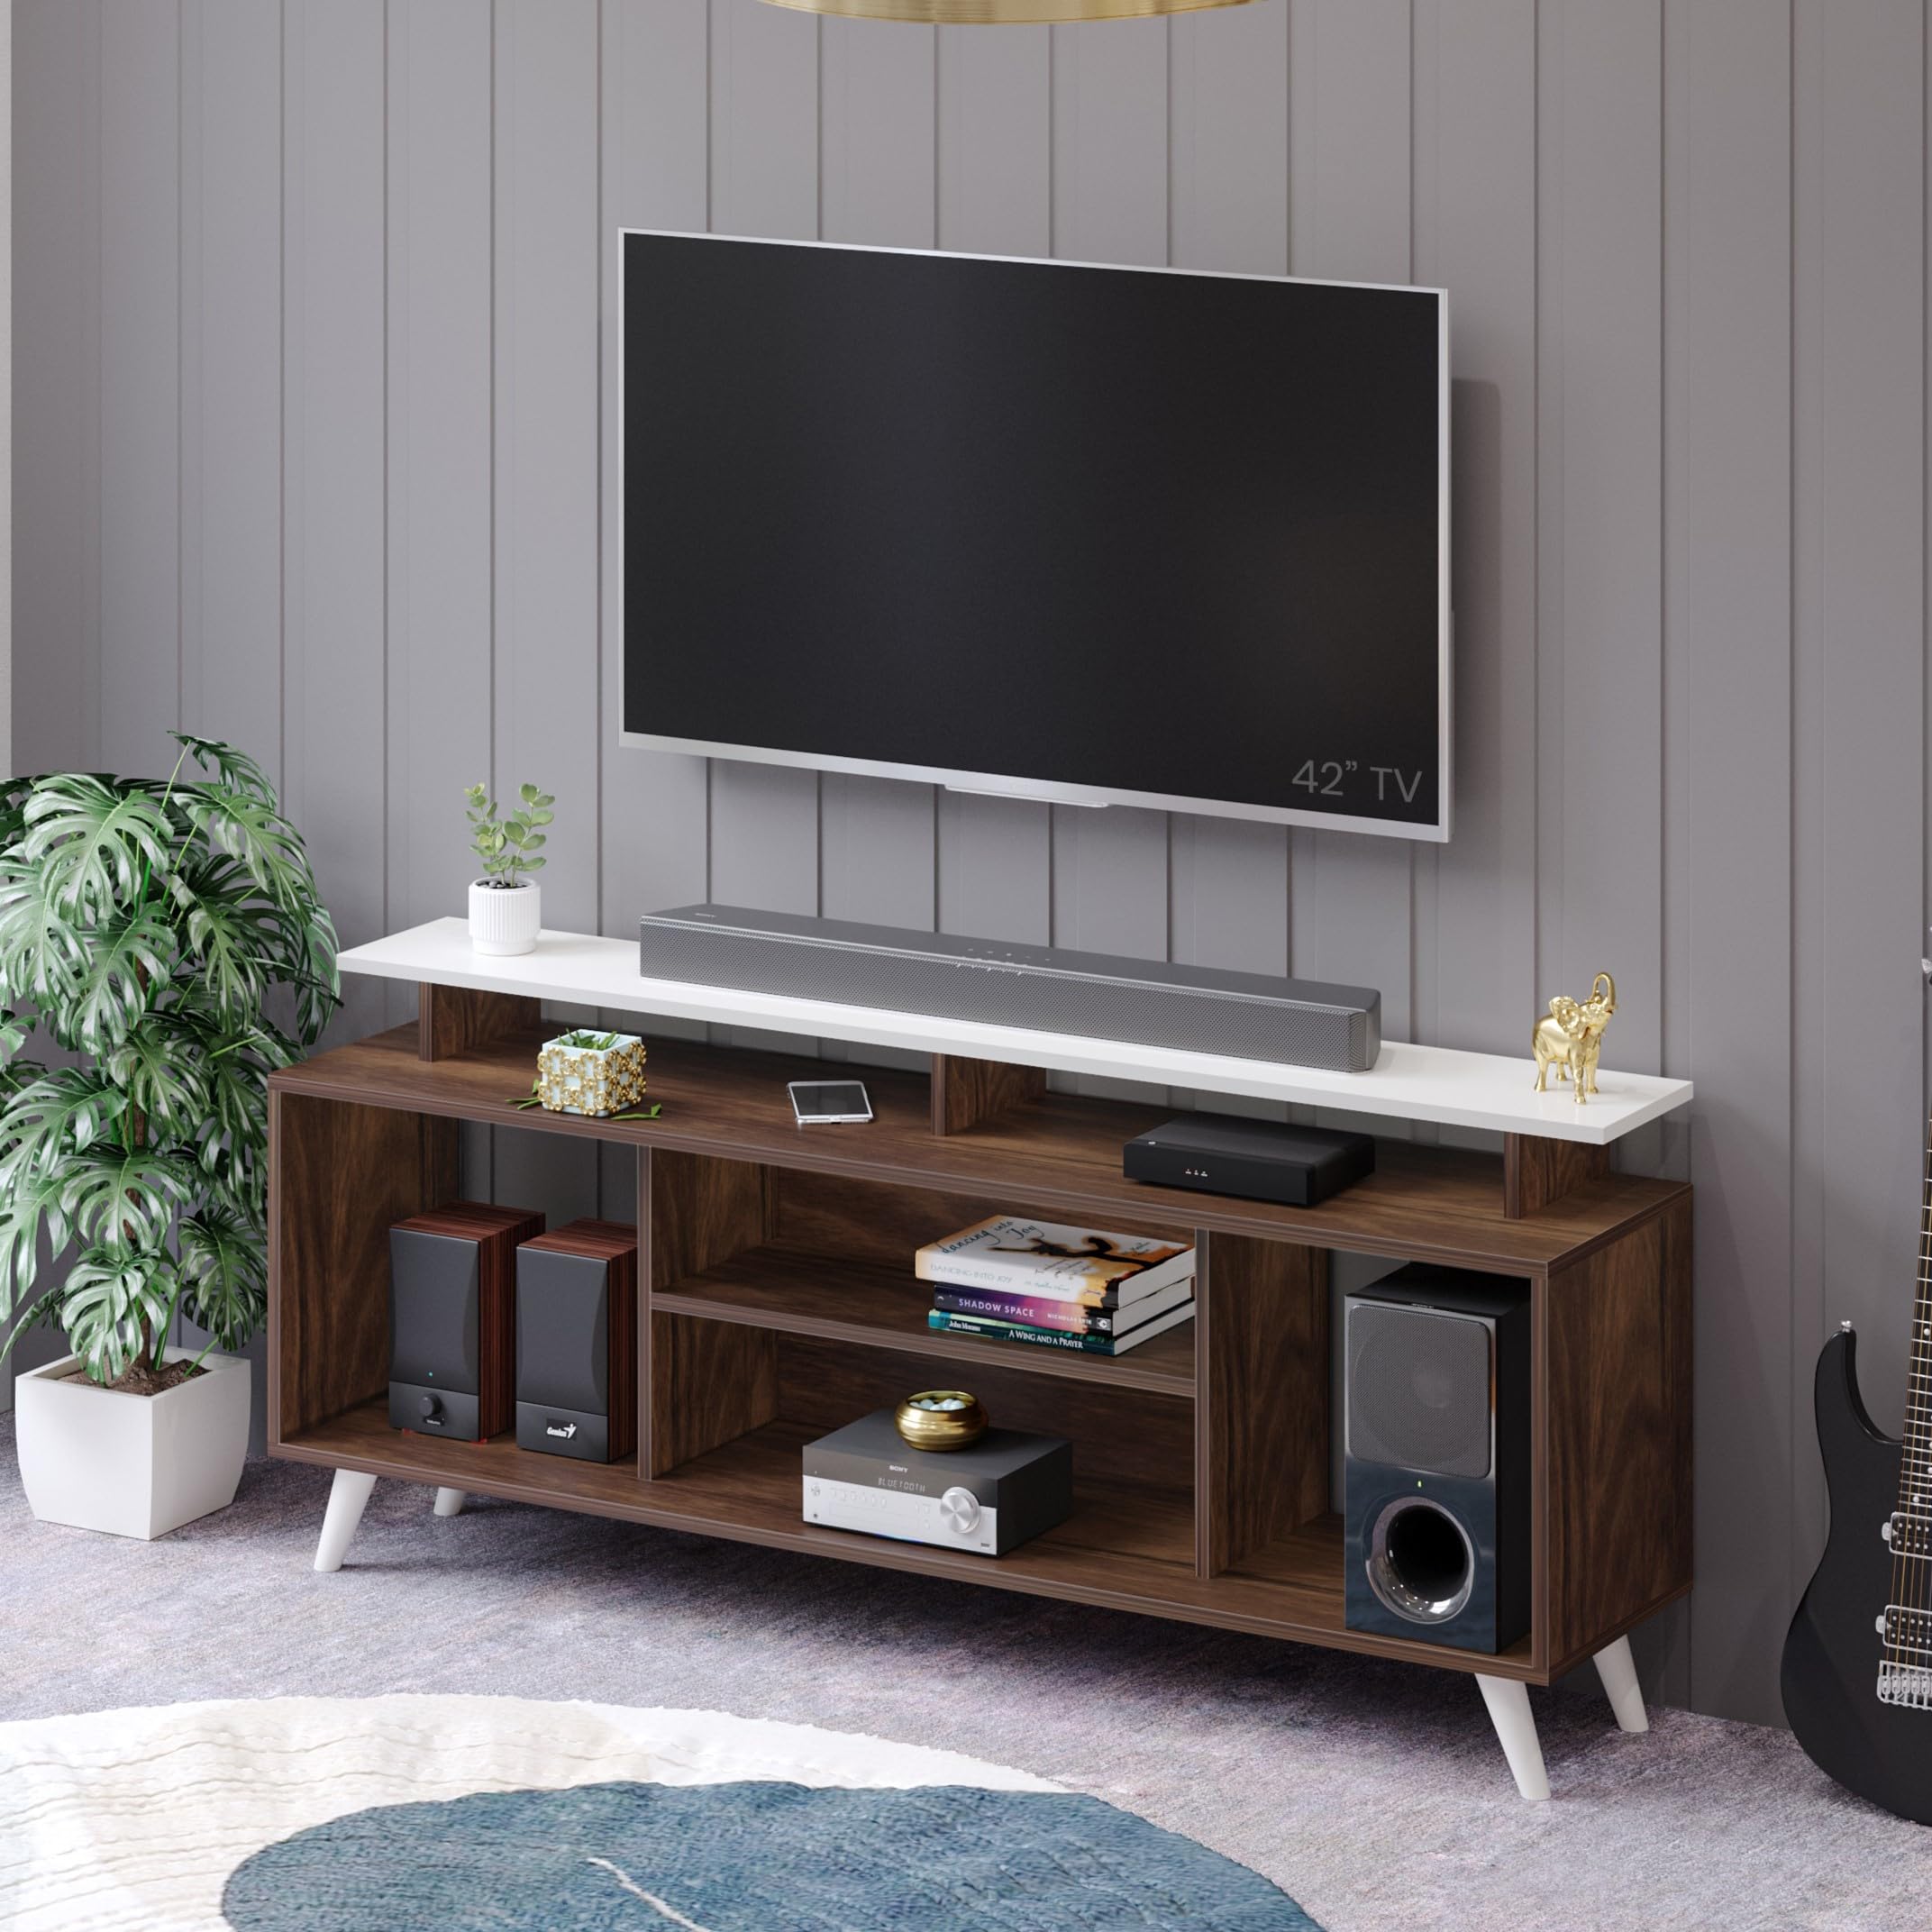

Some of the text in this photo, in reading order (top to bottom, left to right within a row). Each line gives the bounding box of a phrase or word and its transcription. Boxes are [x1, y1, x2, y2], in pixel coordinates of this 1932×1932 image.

[1369, 766, 1423, 803] TV
[1005, 1224, 1045, 1241] Joy
[958, 1298, 1035, 1317] SHADOW SPACE
[1036, 1335, 1053, 1344] AND
[1059, 1336, 1084, 1350] PRAYER
[546, 1426, 567, 1437] Genius
[889, 1464, 908, 1473] SONY
[878, 1477, 925, 1492] BLUETOOTH
